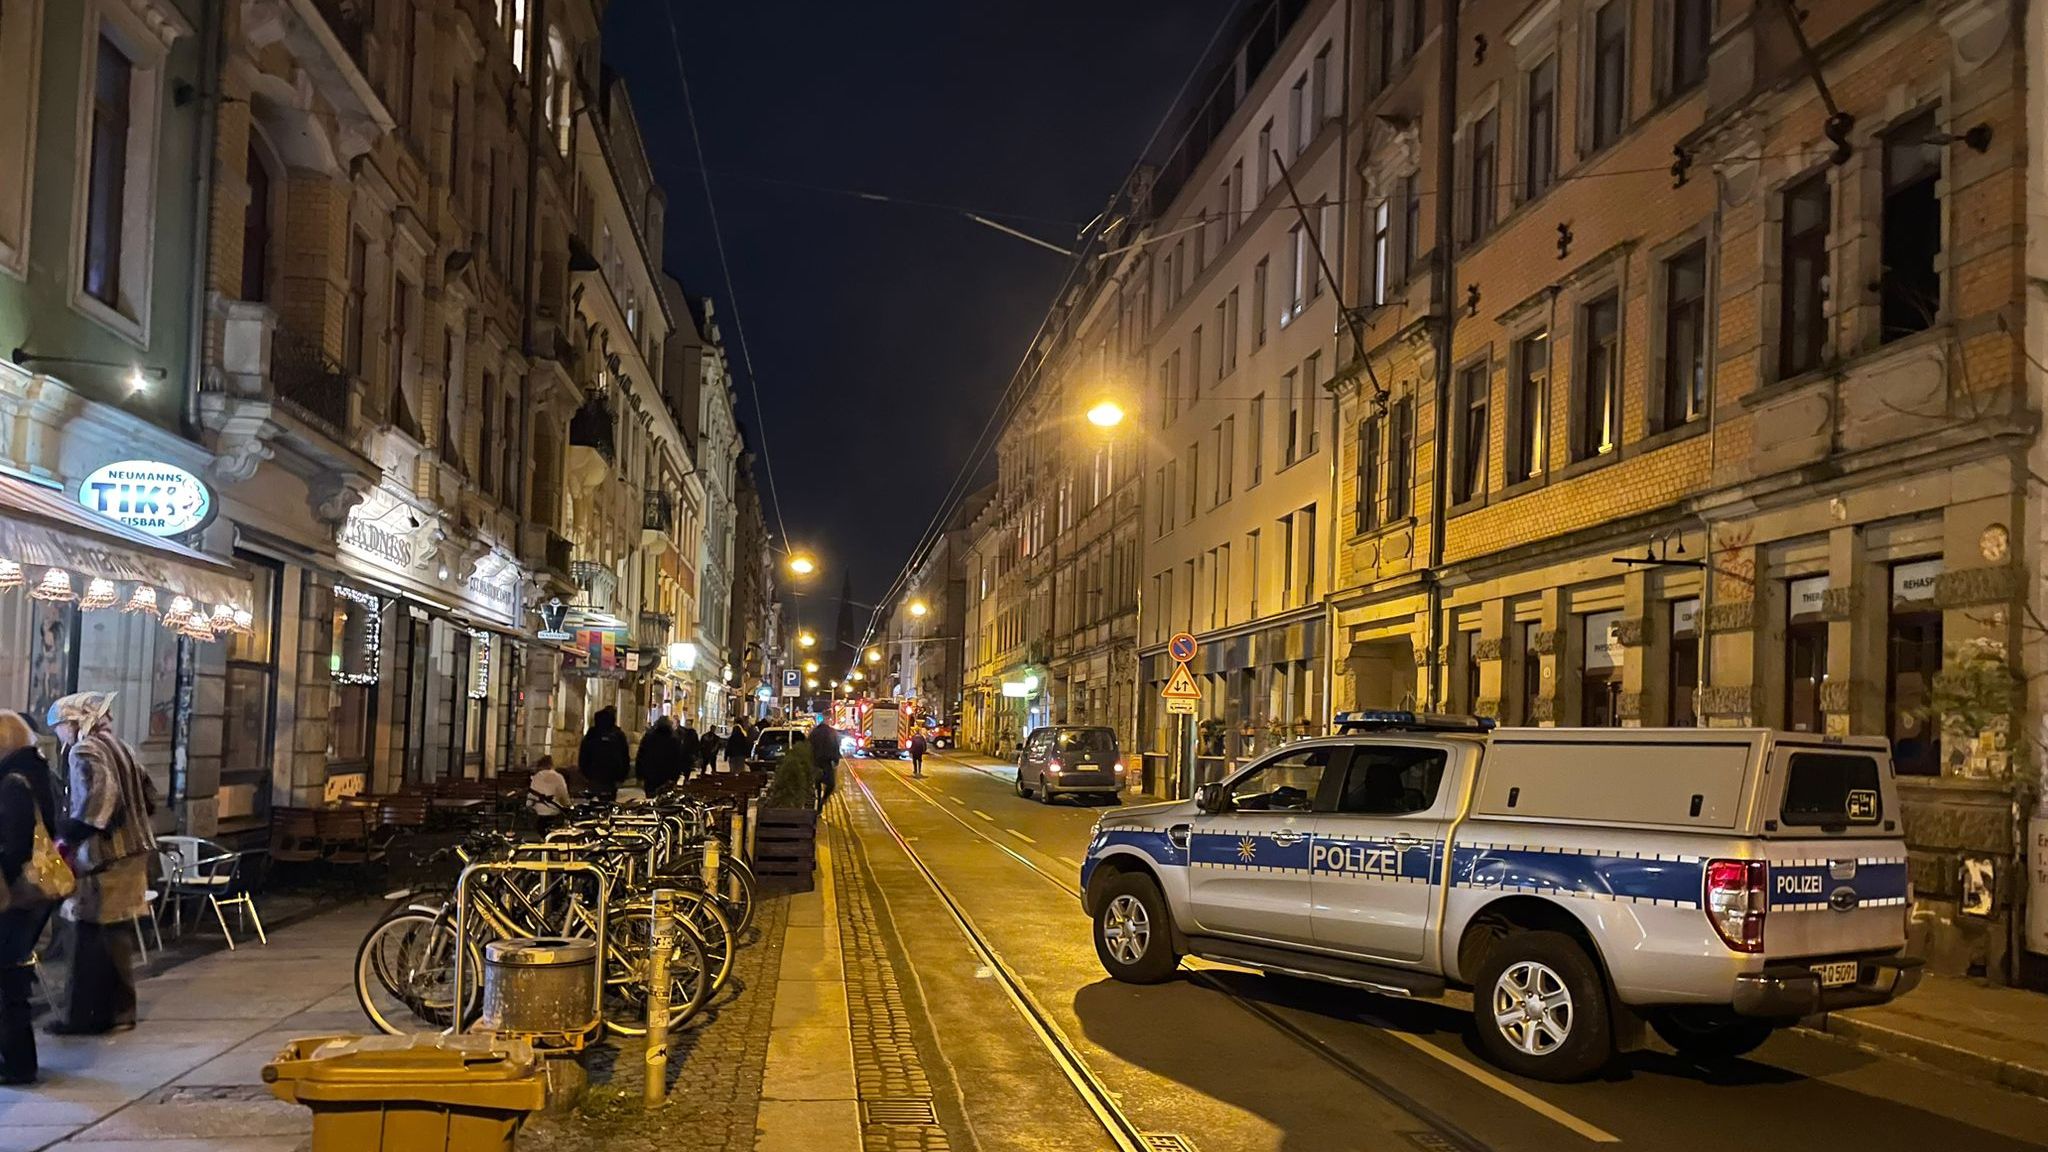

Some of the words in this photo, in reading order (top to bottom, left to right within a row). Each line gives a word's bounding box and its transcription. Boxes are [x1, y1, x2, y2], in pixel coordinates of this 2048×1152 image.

[108, 470, 182, 482] NEUMANNS
[121, 517, 165, 527] EISBAR
[787, 671, 797, 685] P
[1313, 845, 1403, 875] POLIZEI
[1777, 875, 1823, 894] POLIZEI
